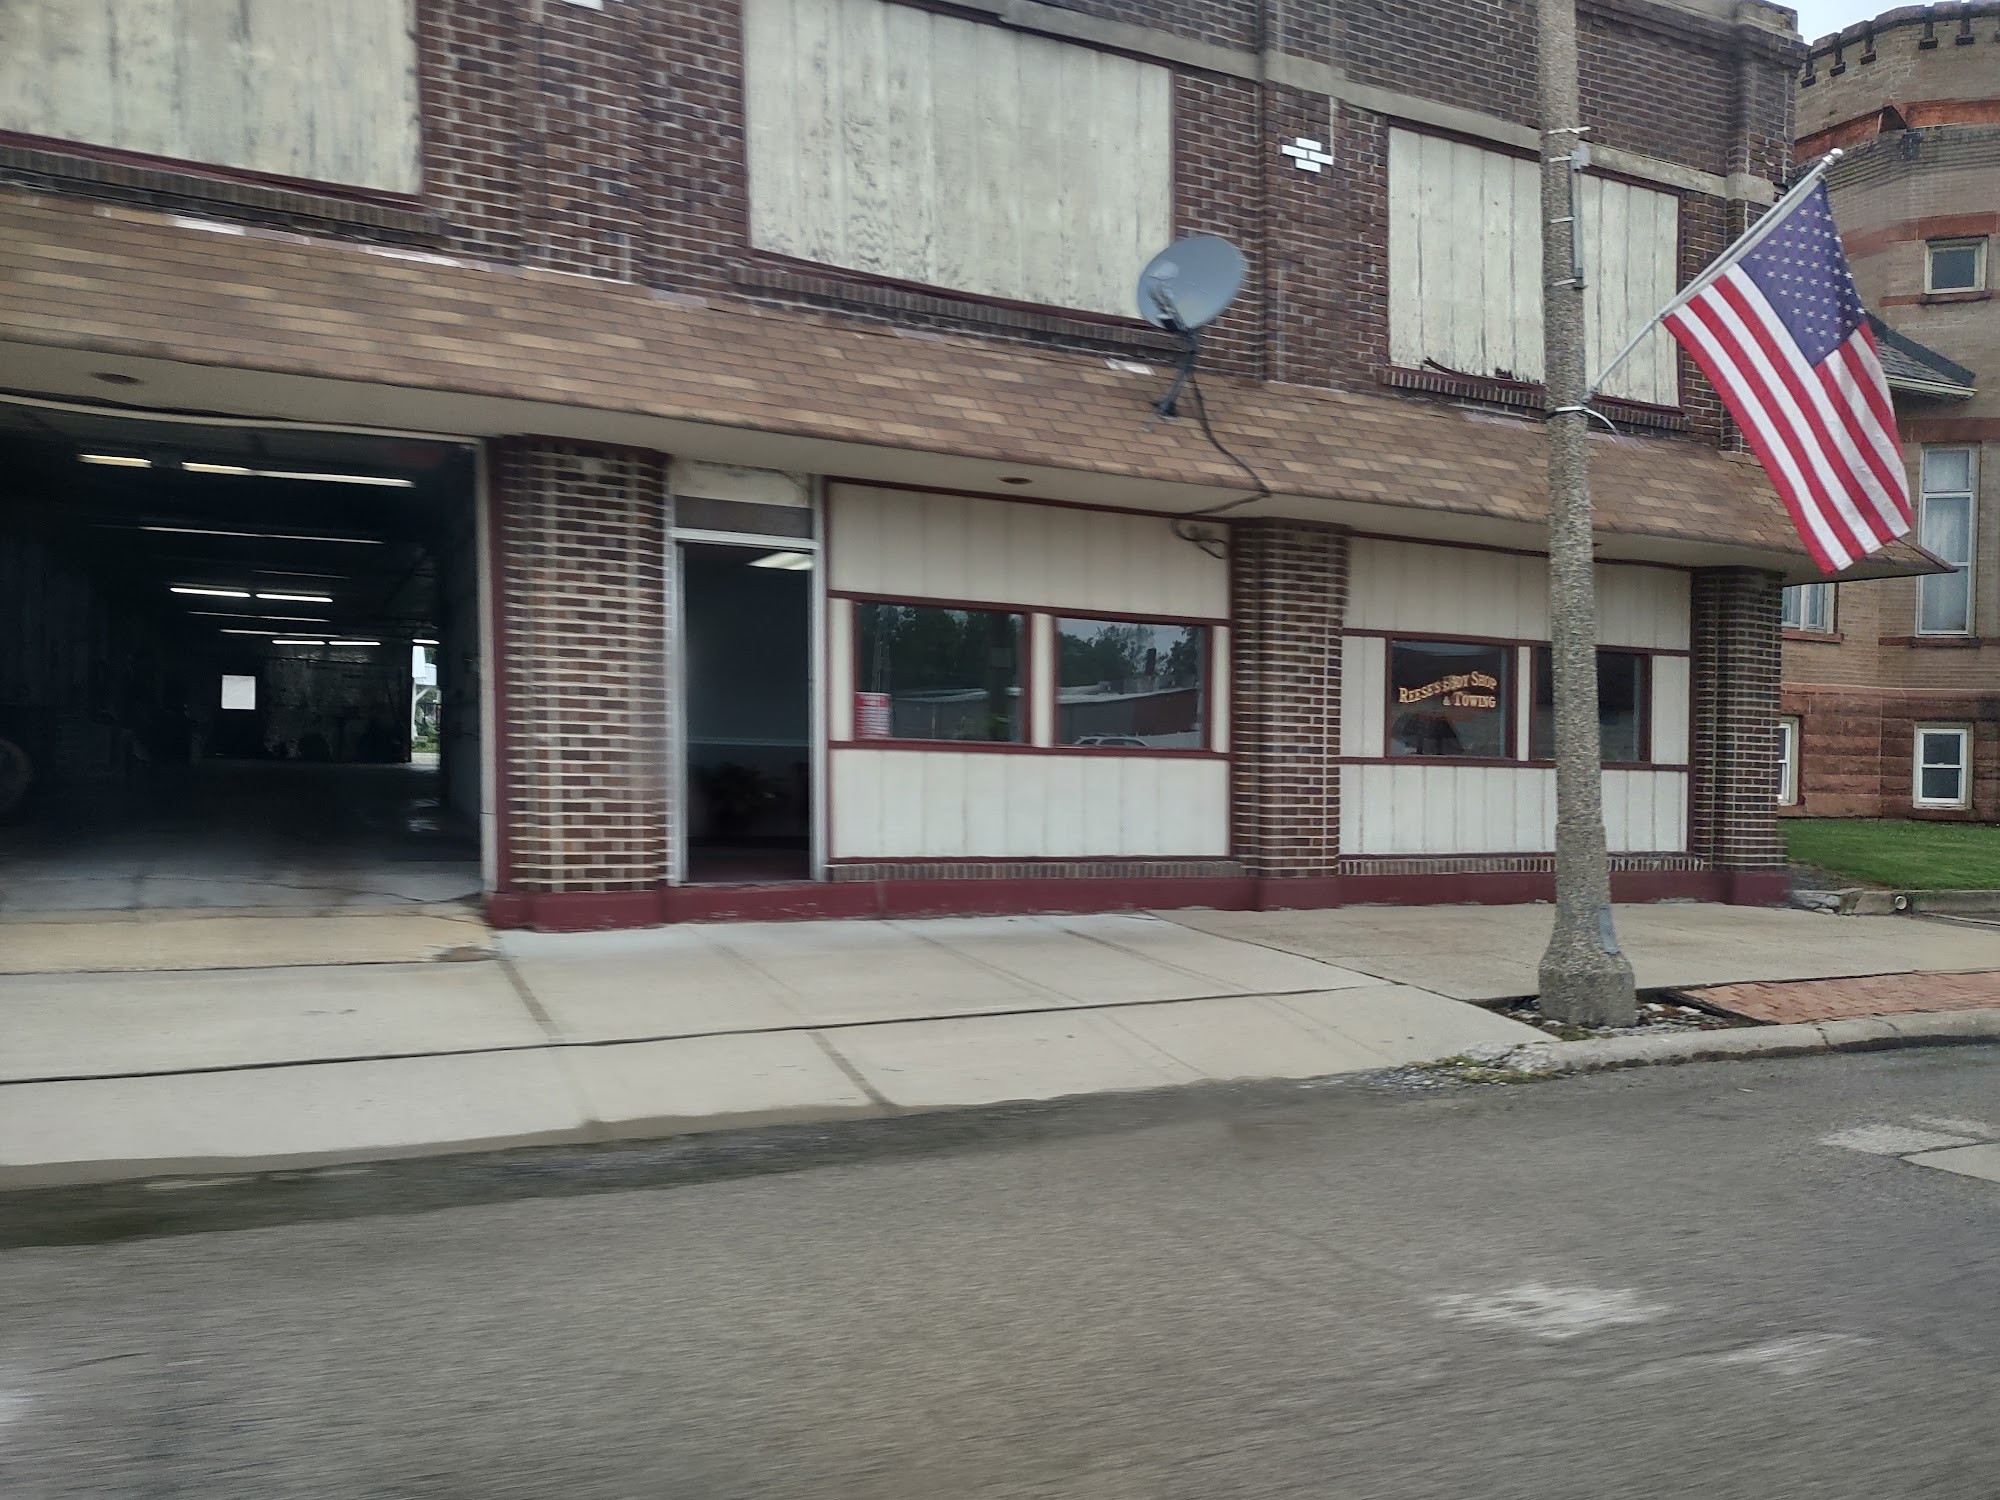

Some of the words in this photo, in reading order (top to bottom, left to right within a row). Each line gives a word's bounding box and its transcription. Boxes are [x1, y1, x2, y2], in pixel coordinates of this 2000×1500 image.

[1470, 671, 1498, 690] SHOP
[1442, 695, 1452, 706] &
[1453, 692, 1497, 708] TOWING
